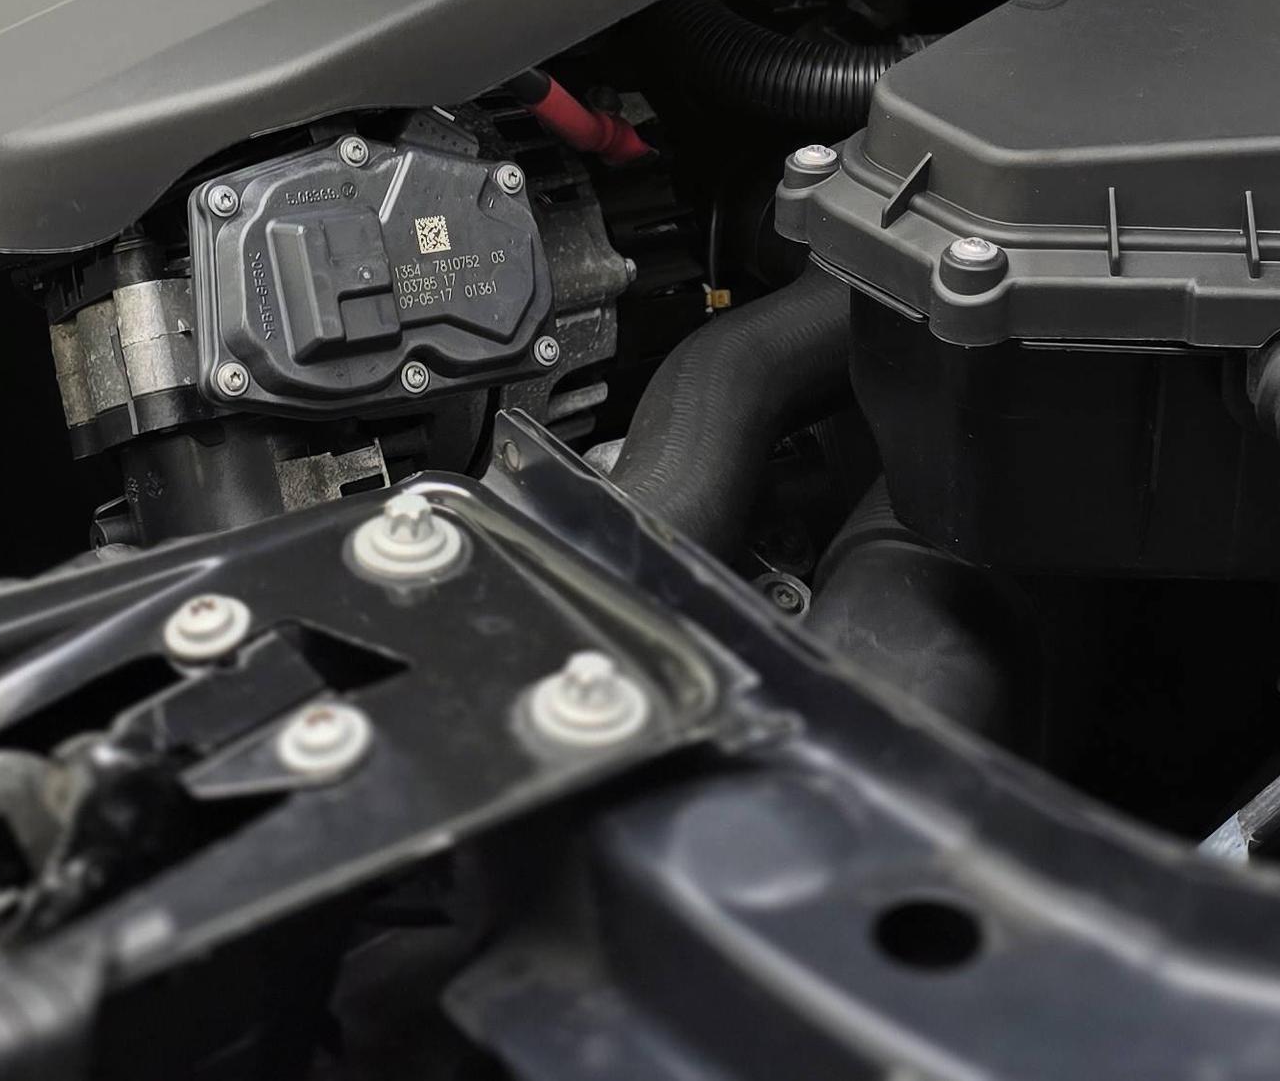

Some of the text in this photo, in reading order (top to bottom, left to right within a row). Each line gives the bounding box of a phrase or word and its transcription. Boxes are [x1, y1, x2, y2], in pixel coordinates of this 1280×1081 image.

[395, 250, 506, 280] 1354 7810752 03
[397, 272, 456, 294] 103785 17
[399, 280, 497, 310] 09-05-17 01361
